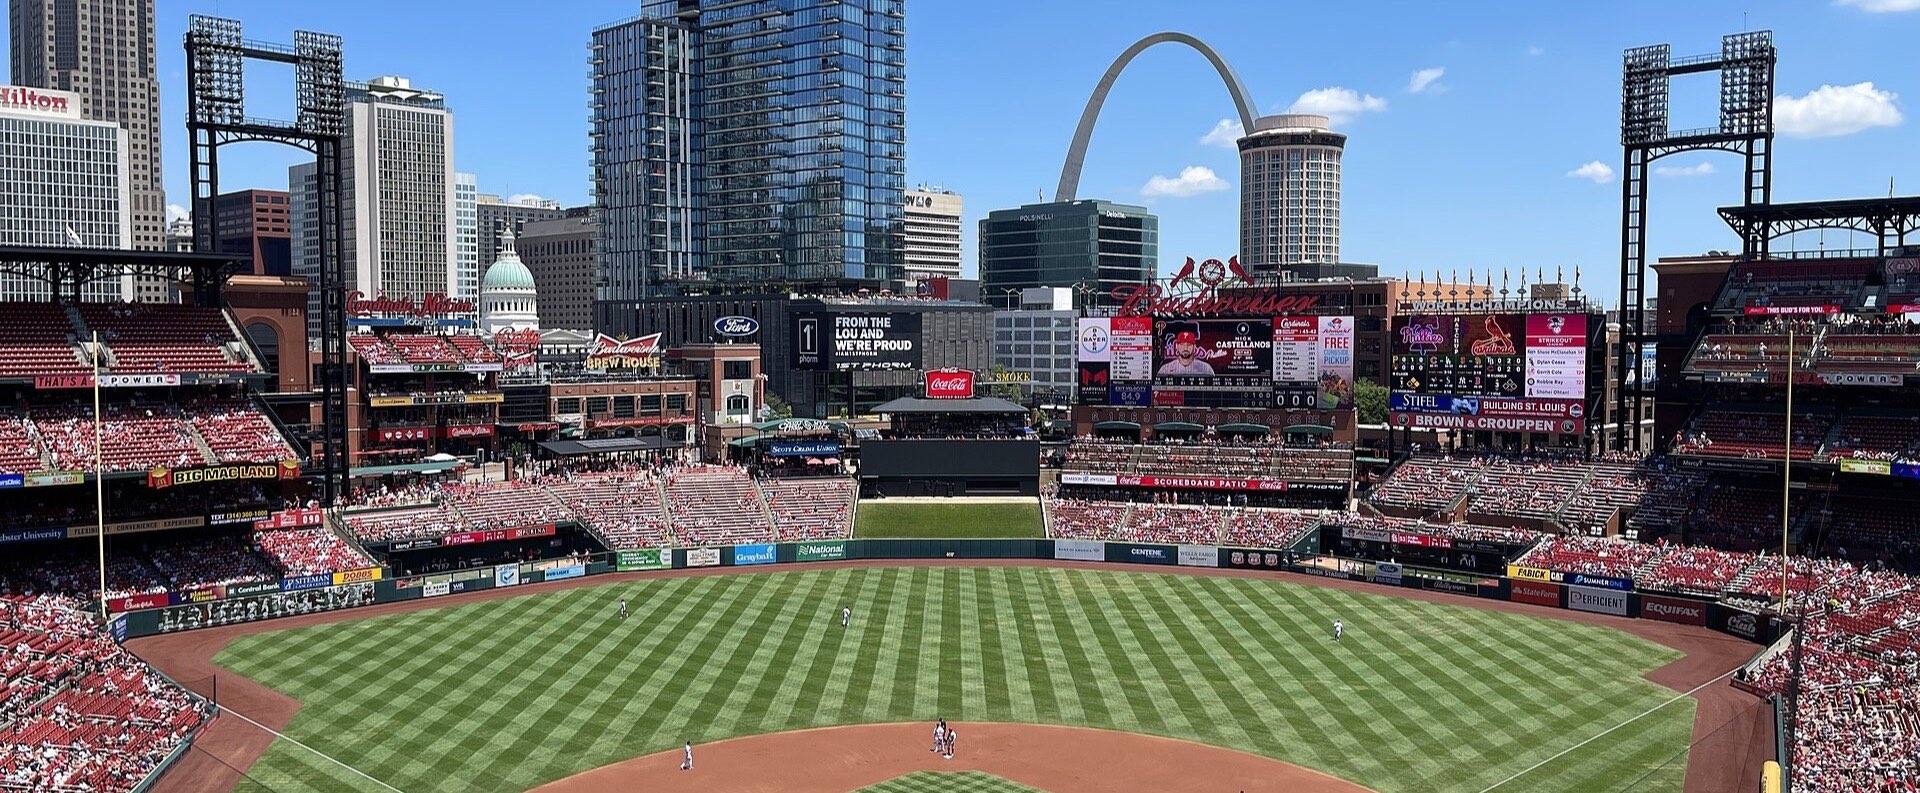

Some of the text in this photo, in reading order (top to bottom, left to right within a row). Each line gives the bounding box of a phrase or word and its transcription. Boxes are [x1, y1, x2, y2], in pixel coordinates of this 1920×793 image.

[1019, 213, 1055, 222] POLSINELLI
[347, 291, 476, 316] Cardinals Nation
[1111, 285, 1319, 317] Budweiser
[1412, 299, 1567, 312] WORLD CHAMPIONS
[724, 319, 751, 332] Ford
[835, 316, 891, 328] FROM THE
[1280, 317, 1311, 328] Cardinals
[835, 328, 884, 339] LOU AND
[1400, 324, 1444, 344] Phillies
[835, 339, 912, 351] WE'RE PROUD
[1216, 341, 1271, 349] CASTELLANOS
[1324, 337, 1349, 349] FREE
[589, 341, 658, 358] Budweiser
[586, 356, 661, 369] BREW HOUSE
[799, 355, 818, 364] phorm
[1324, 356, 1349, 365] PICKUP
[38, 376, 88, 387] THAT'S A
[111, 376, 163, 385] POWER
[996, 372, 1031, 382] SMOKE
[1836, 374, 1887, 383] POWER
[931, 378, 968, 391] Coca-Cola
[1121, 392, 1141, 400] 84.9
[1277, 395, 1315, 406] 0 0 0
[1403, 394, 1438, 407] STIFEL
[1483, 401, 1566, 412] BUILDING ST. LOUIS
[1415, 415, 1554, 431] BROWN & CROUPPEN
[1682, 460, 1699, 468] Mercy
[174, 465, 278, 485] BIG MAC LAND
[1119, 476, 1283, 490] Coca-Cola SCOREBOARD PATIO Coca-Cola
[74, 519, 199, 535] FLEXIBITY CONVENIENCE EXPERIENCE
[522, 528, 546, 536] PURINA
[23, 529, 62, 541] University
[808, 544, 844, 555] National
[1131, 548, 1163, 556] CENTENE
[295, 574, 330, 585] SITEMAN
[343, 570, 373, 579] DOBBS
[1517, 568, 1564, 581] FABICK CAT
[238, 582, 280, 594] Central Bank
[1570, 591, 1624, 609] PERFICIENT
[1645, 602, 1700, 617] EQUIFAX
